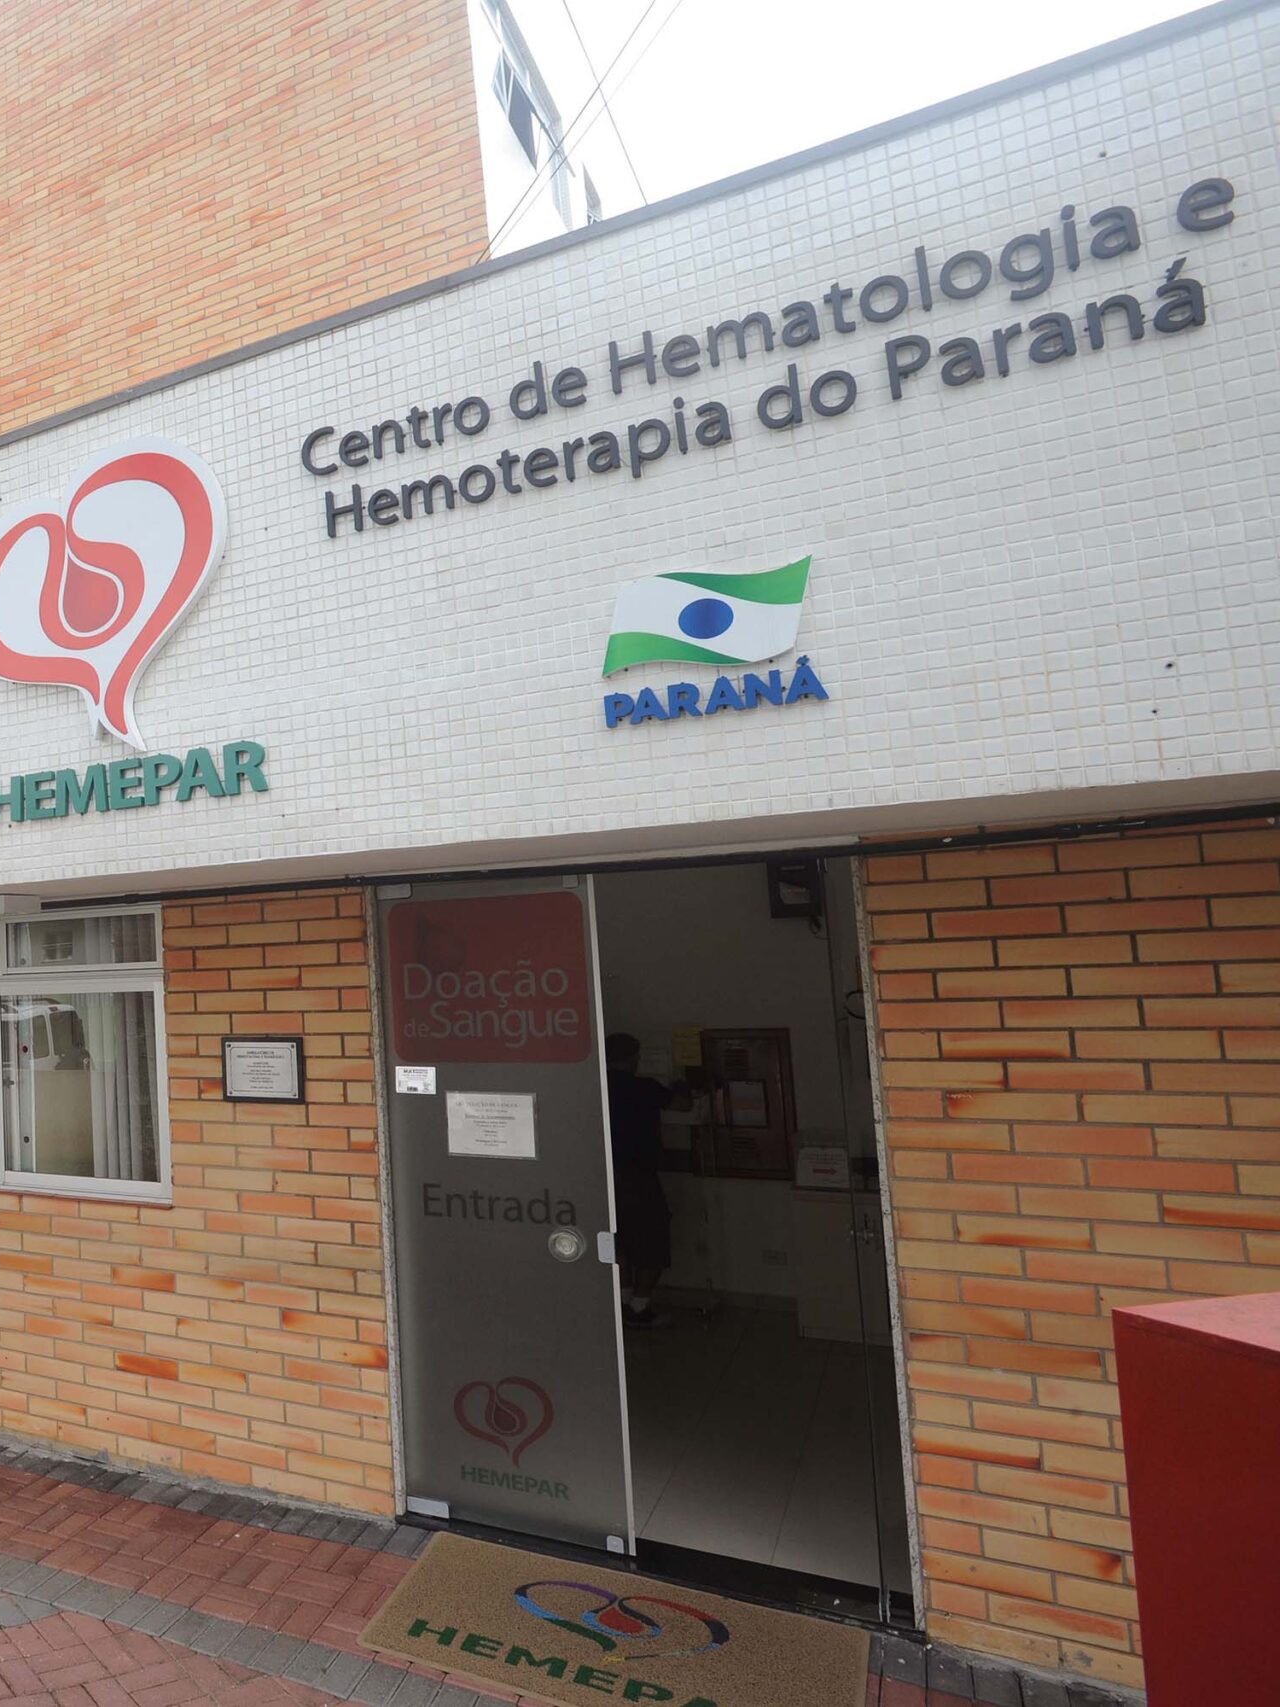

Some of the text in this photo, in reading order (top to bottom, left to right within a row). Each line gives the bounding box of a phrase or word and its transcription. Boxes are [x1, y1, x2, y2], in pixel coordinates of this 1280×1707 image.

[301, 177, 1235, 476] Centro de Hematologia e
[325, 257, 1206, 538] Hemoterapia do Paraná
[603, 655, 829, 728] PARANÁ
[403, 960, 569, 1008] Doação
[429, 1001, 578, 1048] Sangue
[423, 1183, 577, 1227] Entrada
[460, 1463, 569, 1500] HEMEPAR
